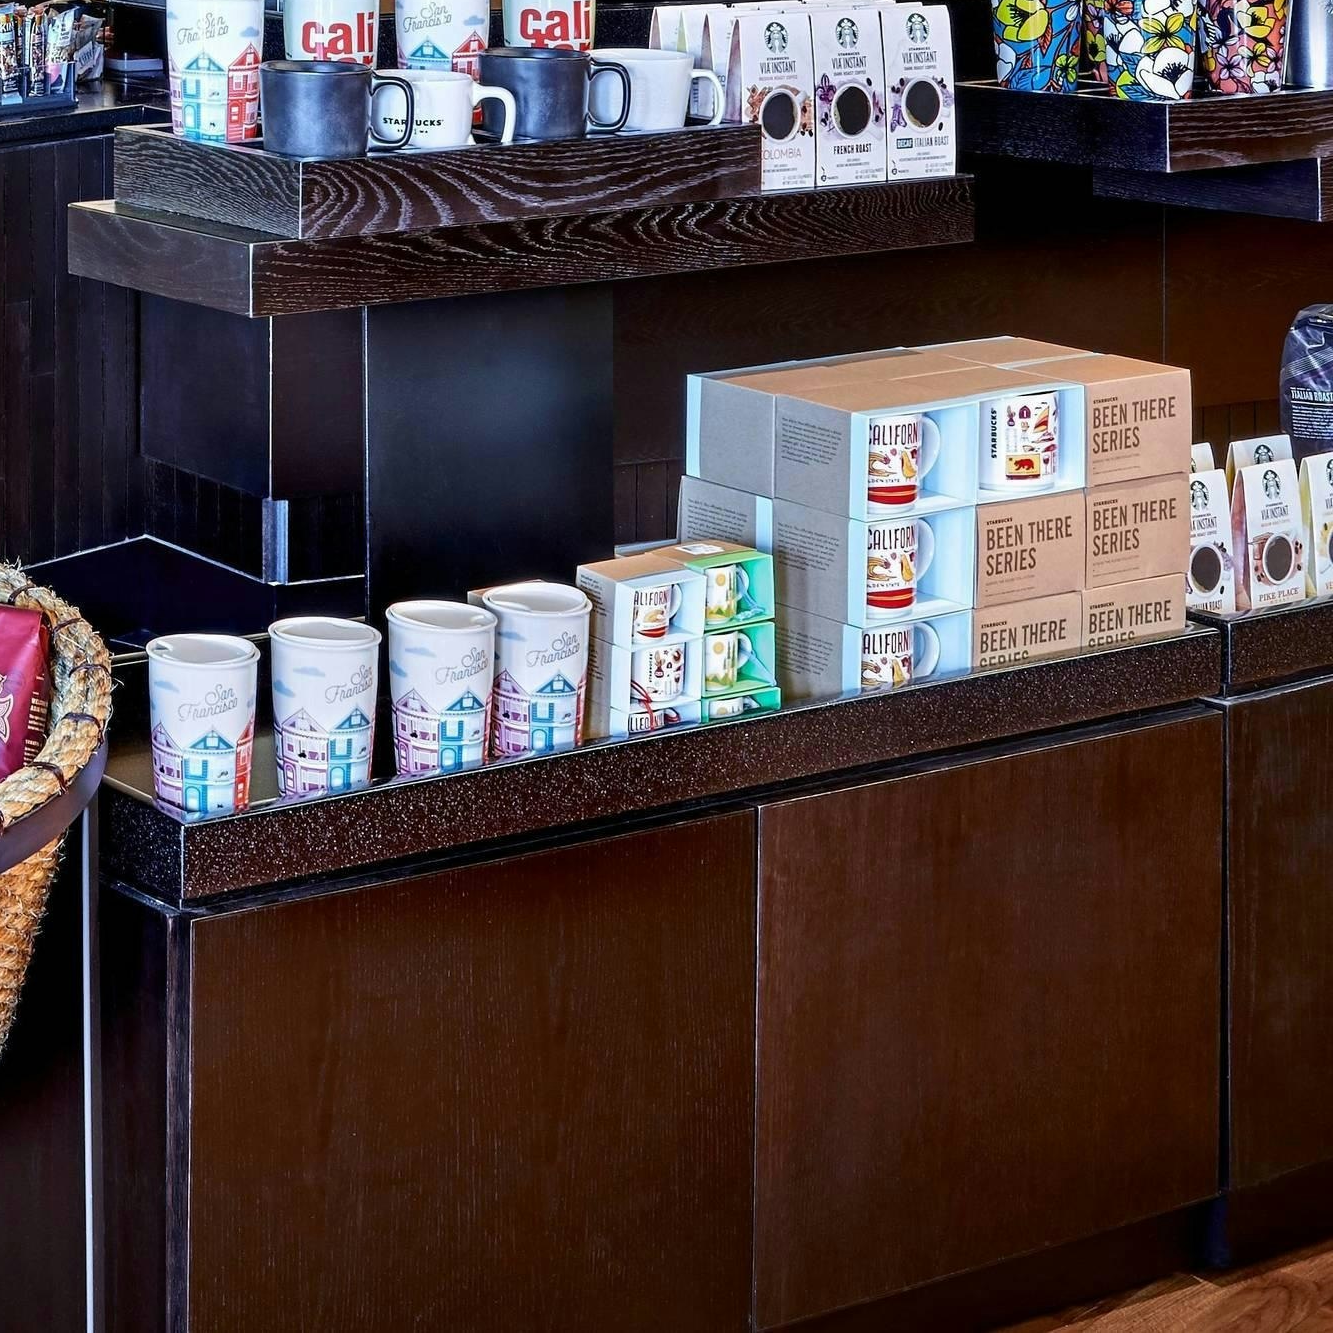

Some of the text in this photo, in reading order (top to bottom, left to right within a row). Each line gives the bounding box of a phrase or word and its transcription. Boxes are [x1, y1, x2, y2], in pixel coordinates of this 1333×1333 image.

[301, 11, 374, 54] cali
[519, 0, 591, 42] cali
[832, 56, 866, 69] VIA INSTANT
[382, 117, 443, 128] STARUCKS
[833, 143, 872, 154] FRENCH ROAST
[1093, 397, 1118, 405] STARBUCKS
[1093, 396, 1176, 428] BEEN THERE
[1093, 426, 1140, 454] SERIES
[986, 517, 1013, 525] STARBUCKS
[1093, 498, 1177, 531] BEEN THERE
[986, 516, 1073, 551] BEEN THERE
[1093, 529, 1140, 557] SERIES
[986, 548, 1036, 576] SERIES
[1259, 587, 1298, 601] PIKE PLACE
[552, 632, 578, 652] San
[527, 643, 580, 667] Francisco
[205, 684, 234, 706] San
[178, 698, 238, 722] Francisco
